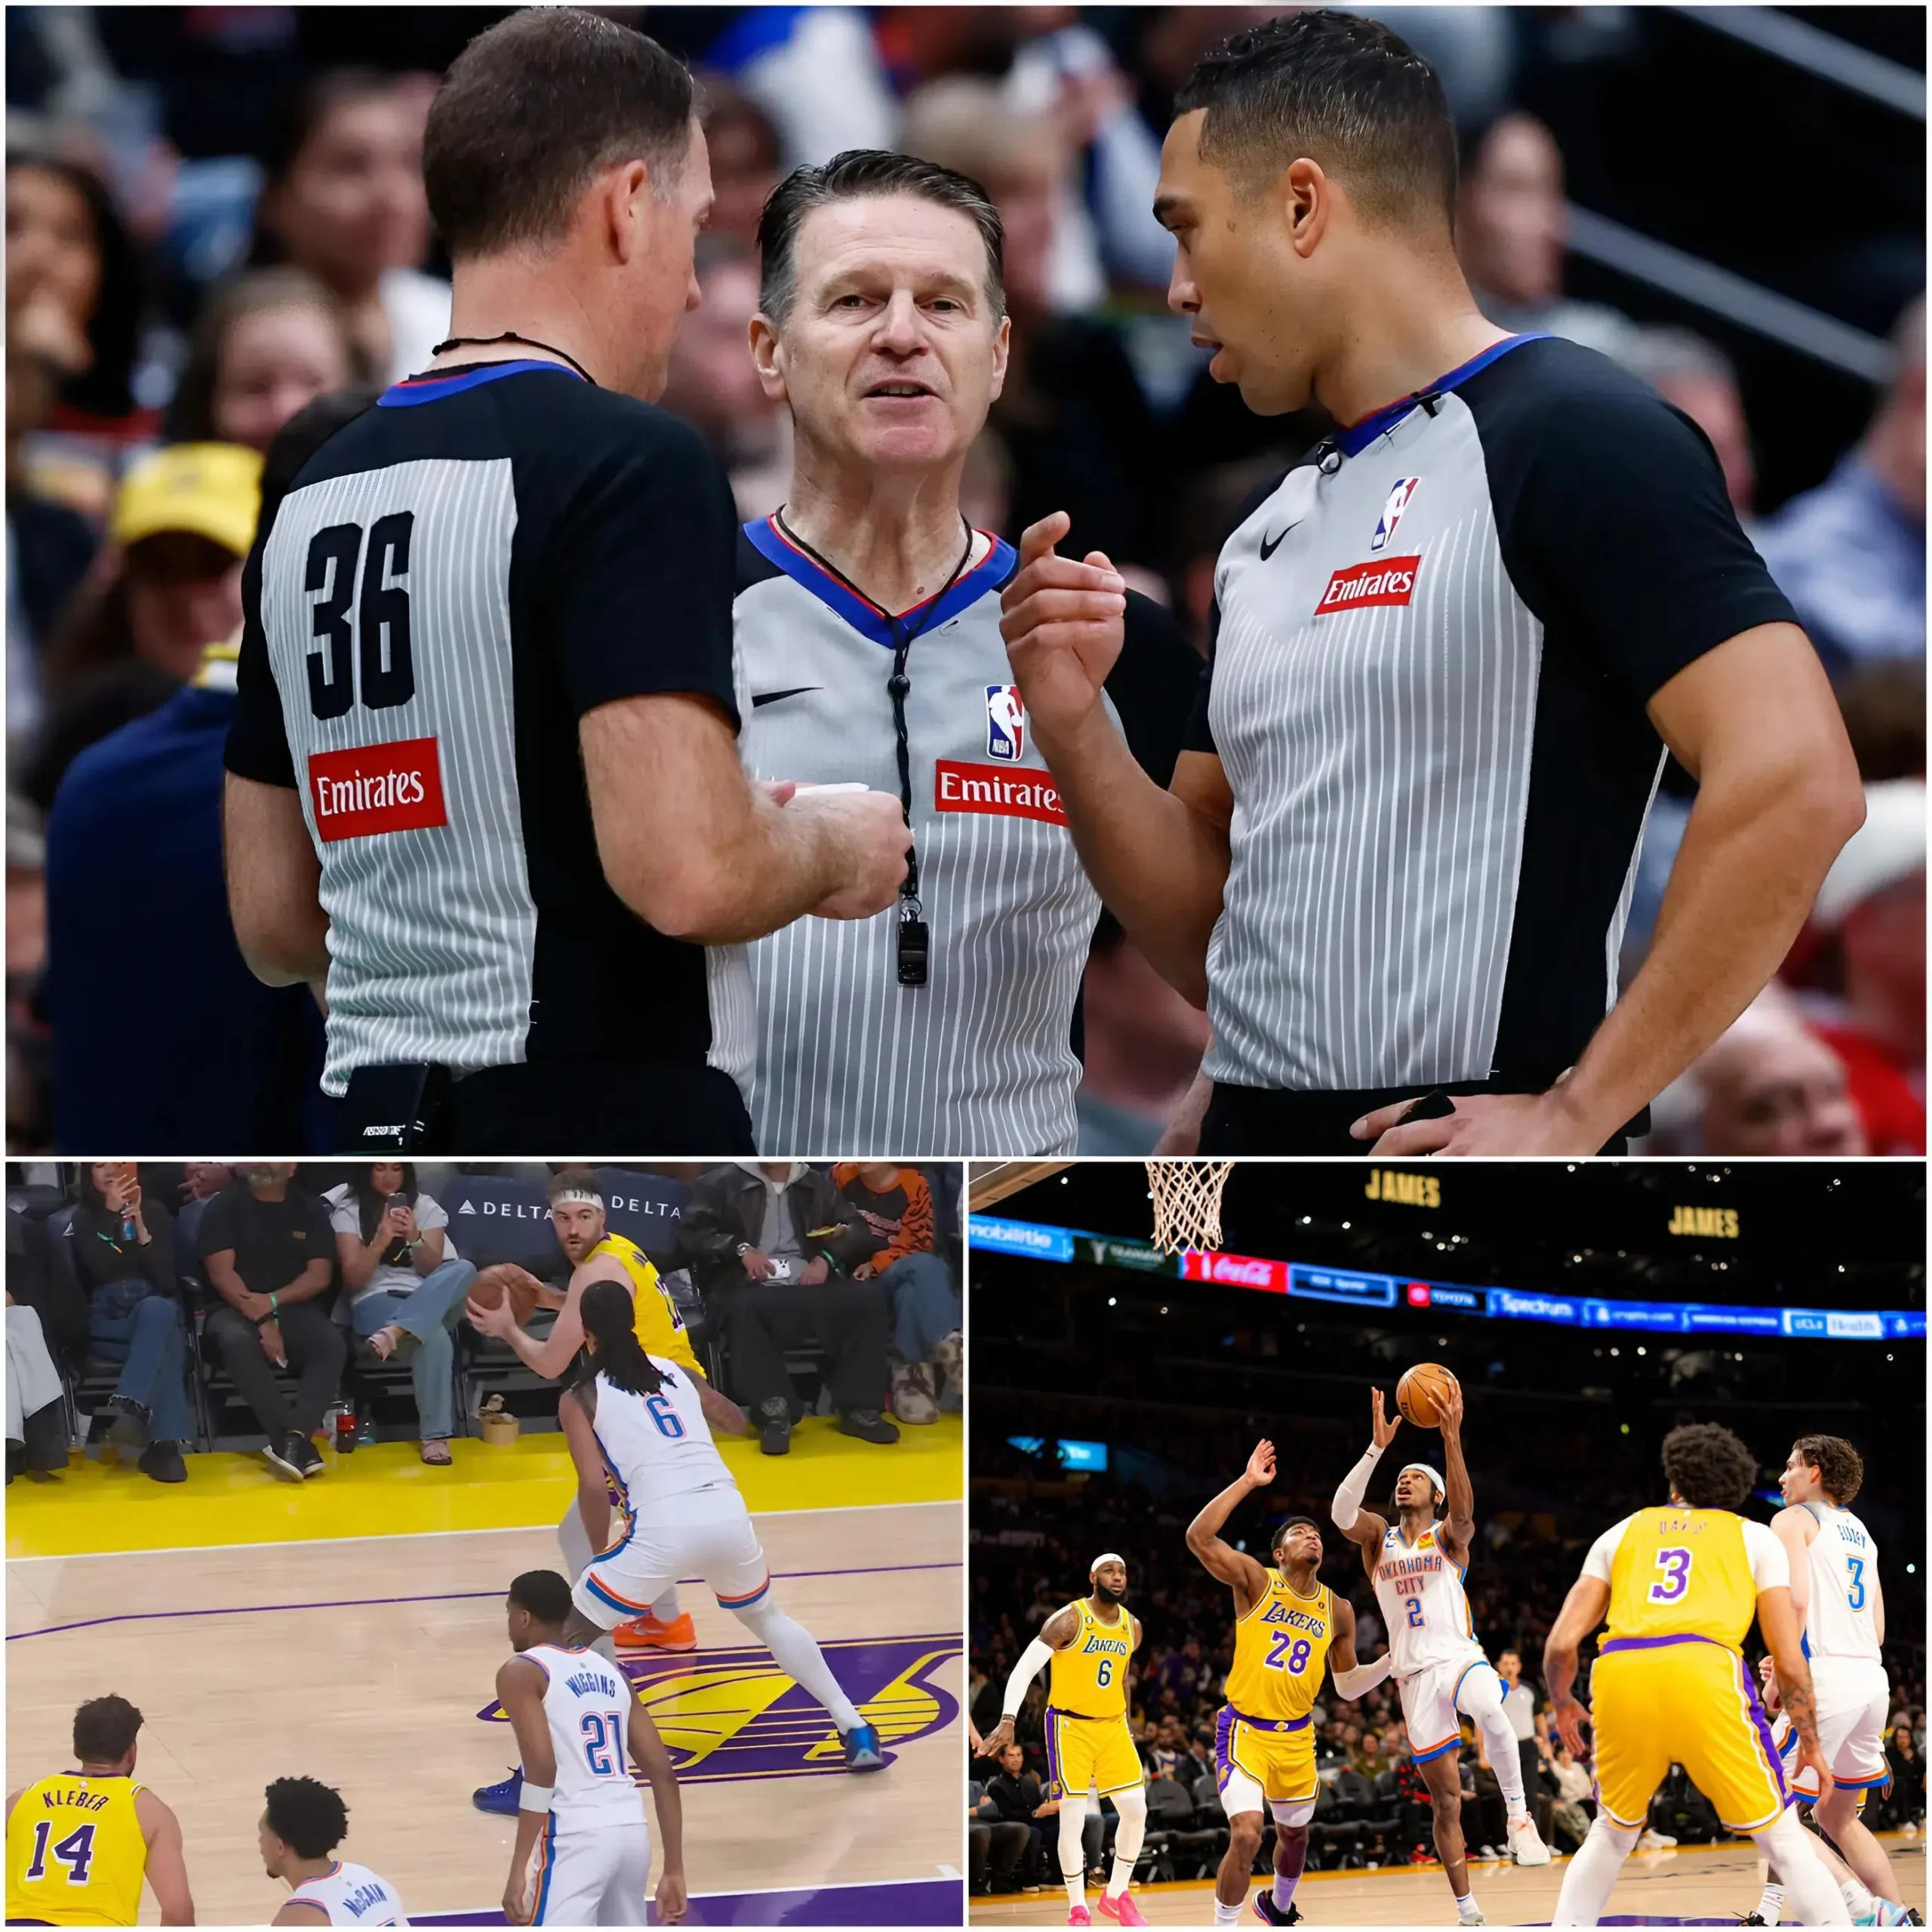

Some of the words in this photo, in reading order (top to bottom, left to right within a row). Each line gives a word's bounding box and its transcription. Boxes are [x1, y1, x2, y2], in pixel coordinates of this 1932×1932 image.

[1323, 569, 1414, 605] Emirates
[304, 510, 415, 721] 36
[317, 768, 424, 817] Emirates
[1364, 1168, 1441, 1208] JAMES
[611, 1195, 681, 1220] DELTA
[1668, 1205, 1739, 1238] JAMES
[643, 1393, 687, 1439] 6
[1378, 1555, 1443, 1582] OKLAHOMA
[1395, 1575, 1425, 1595] CITY
[1647, 1546, 1694, 1605] 3
[1846, 1553, 1867, 1612] 3
[1260, 1601, 1325, 1638] LAKERS
[1405, 1597, 1426, 1629] 2
[1263, 1629, 1312, 1675] 28
[565, 1672, 616, 1698] WIGGINS
[1097, 1658, 1113, 1688] 6
[580, 1711, 628, 1778] 21
[42, 1789, 109, 1811] KLEBER
[24, 1820, 97, 1887] 14
